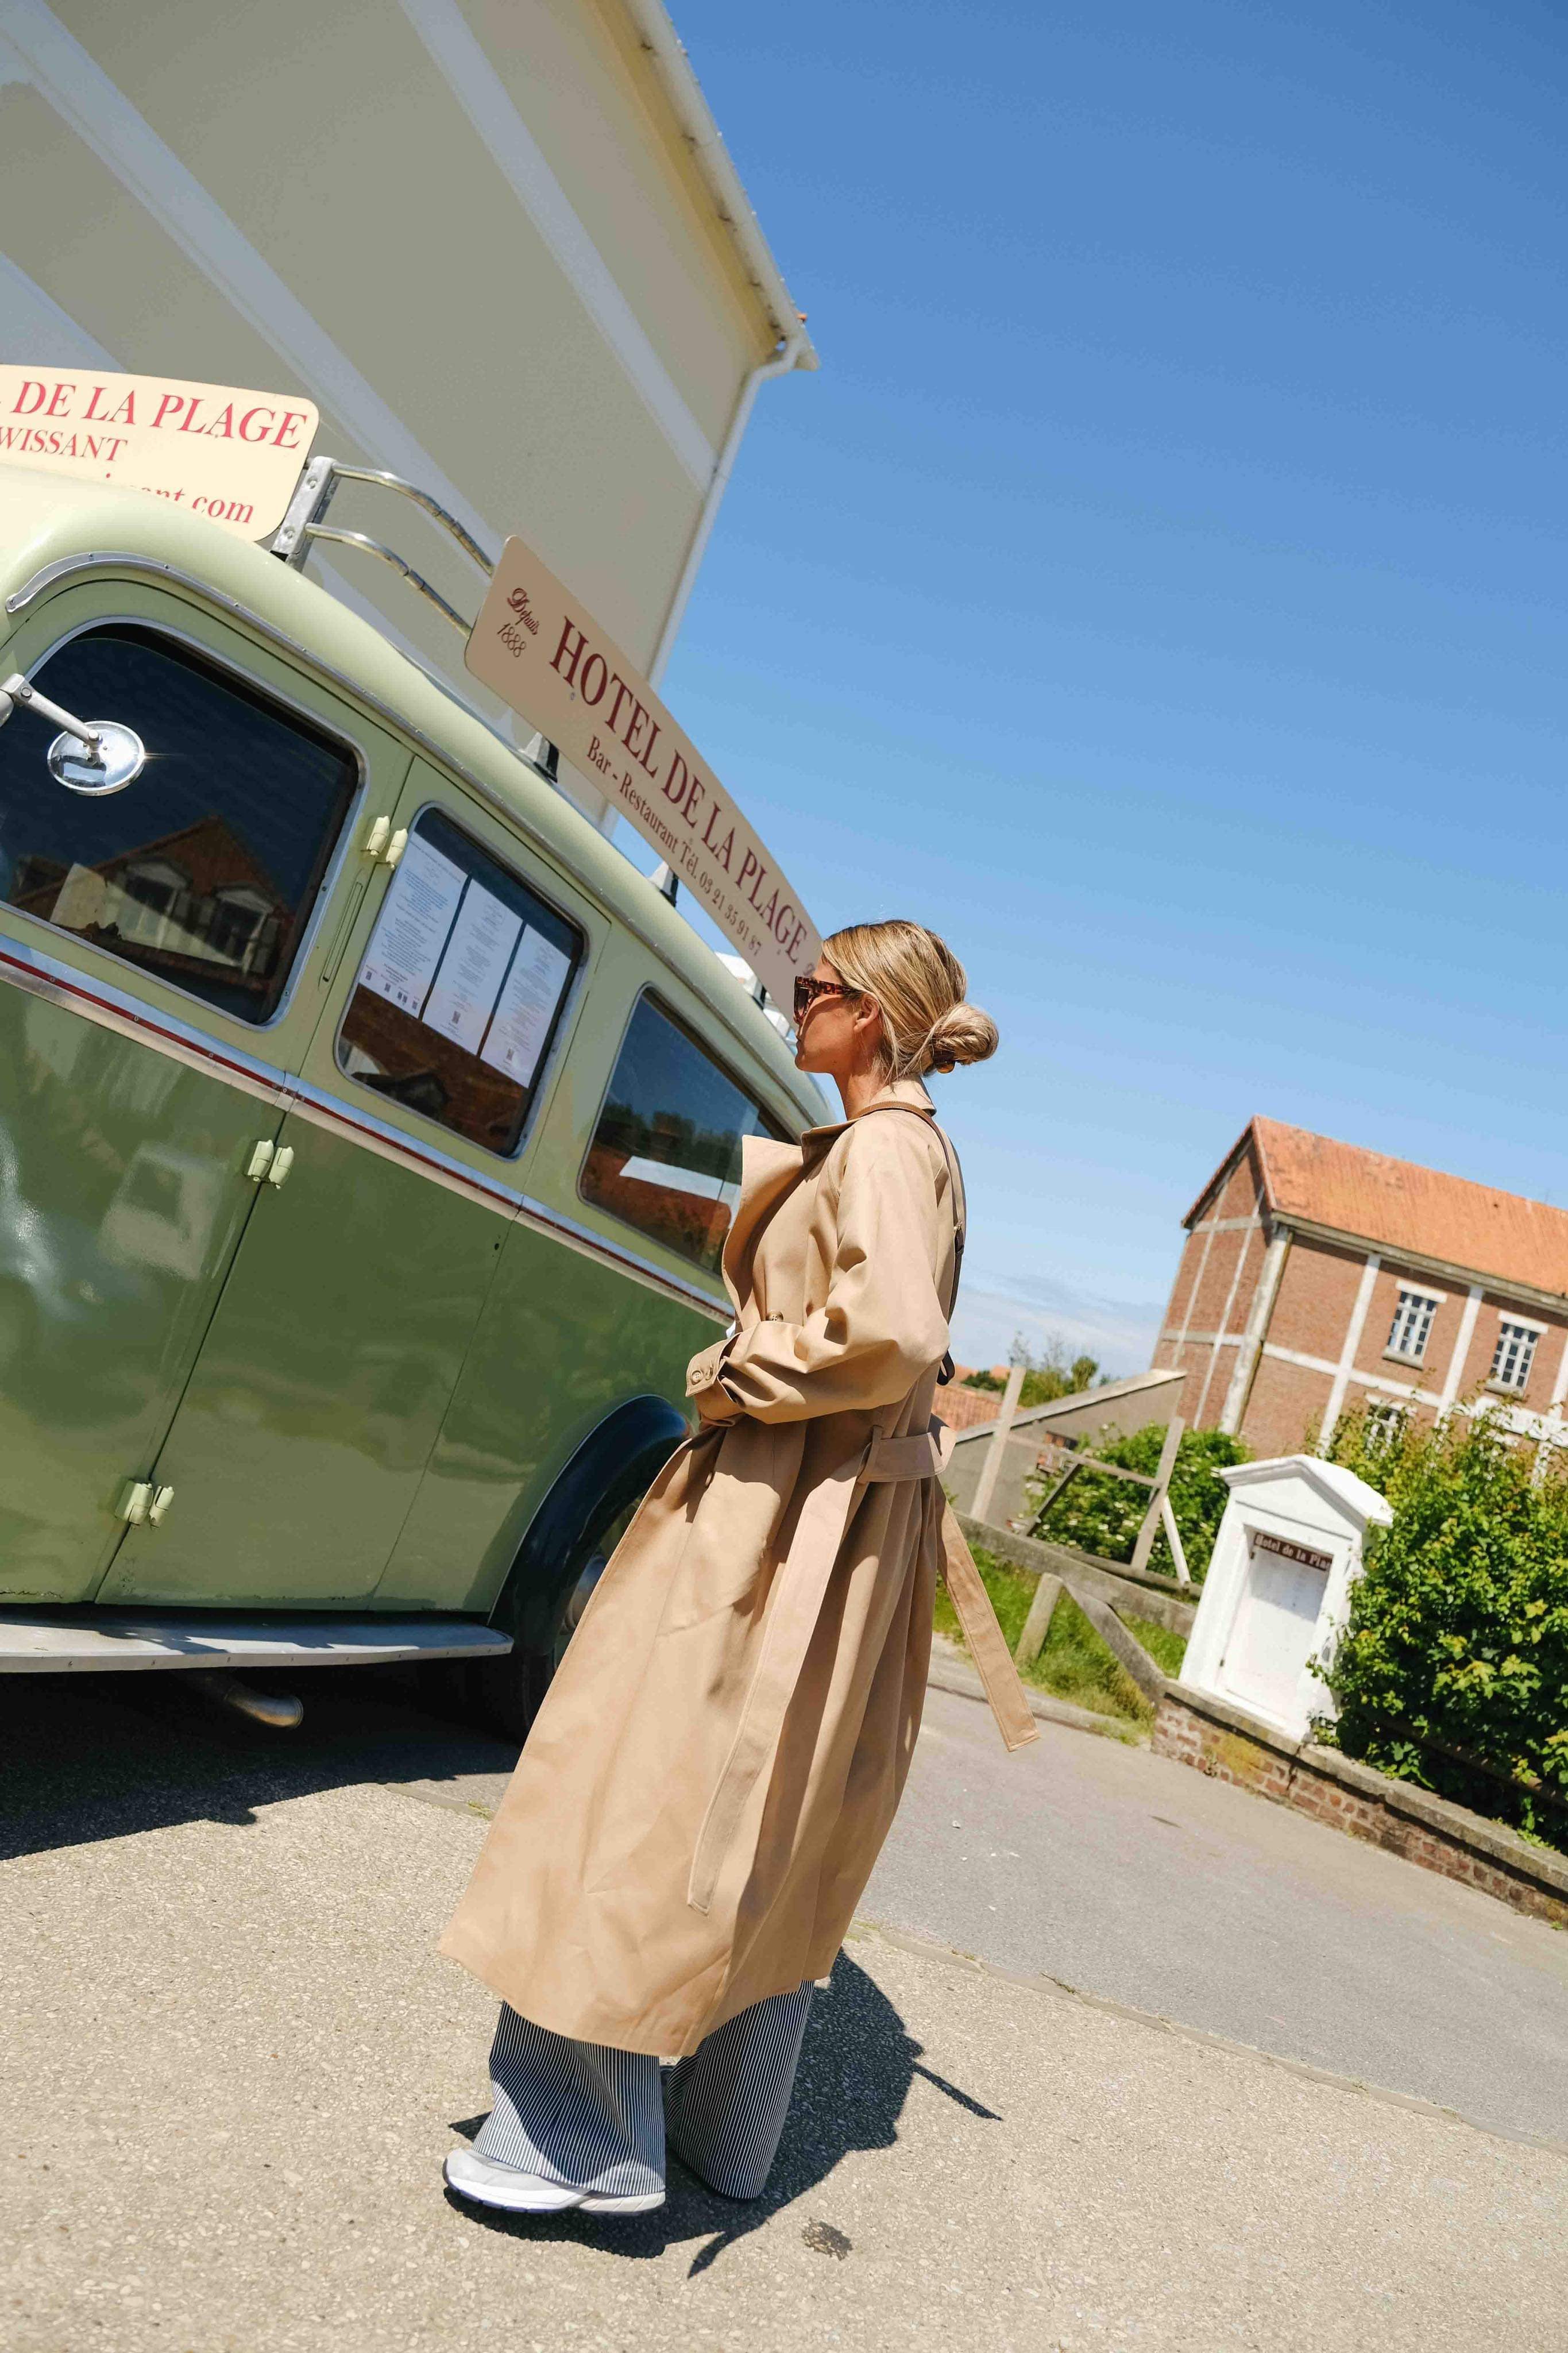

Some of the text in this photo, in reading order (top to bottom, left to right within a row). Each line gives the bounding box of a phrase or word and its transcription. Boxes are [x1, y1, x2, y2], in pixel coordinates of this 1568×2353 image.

[9, 380, 308, 450] DE LA PLAGE
[0, 426, 128, 462] WISSANT
[507, 588, 539, 635] Depuis
[497, 623, 526, 658] 1888
[549, 616, 808, 965] HOTEL DE LA PLAGE
[587, 734, 612, 774] Bar
[619, 770, 679, 854] Restaurant
[699, 871, 714, 894] 03
[712, 889, 725, 911] 21
[725, 904, 738, 926] 35
[736, 920, 749, 942] 91
[1281, 1545, 1294, 1557] de
[1296, 1549, 1306, 1562] la
